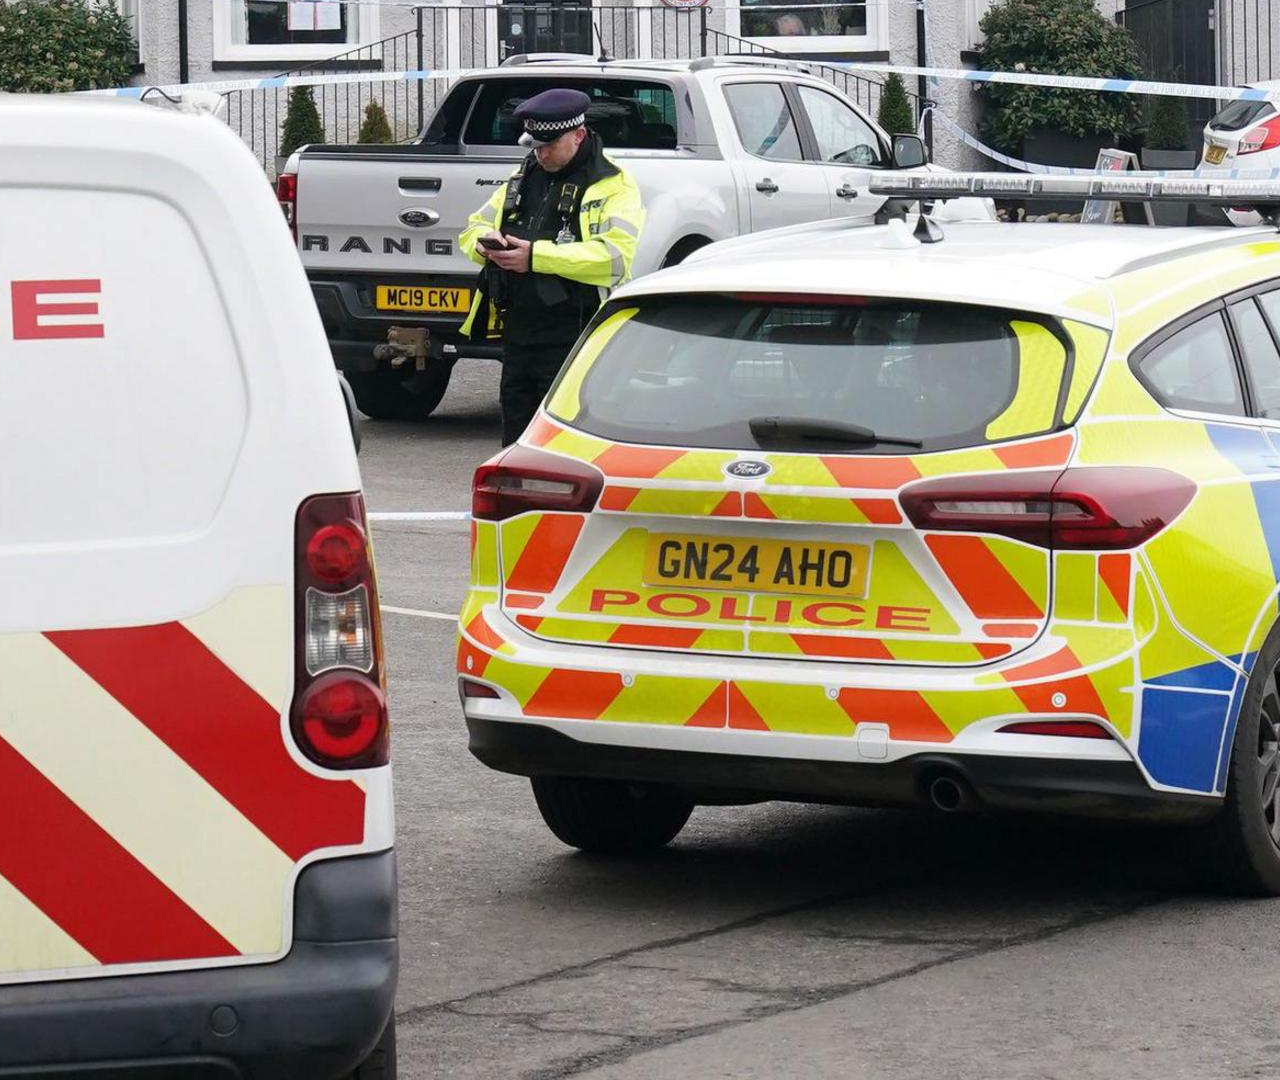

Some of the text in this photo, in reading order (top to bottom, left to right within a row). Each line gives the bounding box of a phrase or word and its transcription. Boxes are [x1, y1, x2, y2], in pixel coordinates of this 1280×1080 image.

[302, 234, 453, 256] RANG
[388, 288, 460, 308] MC19 CKV
[733, 463, 761, 474] Ford
[658, 540, 852, 588] GN24 AHO
[589, 589, 931, 631] POLICE
